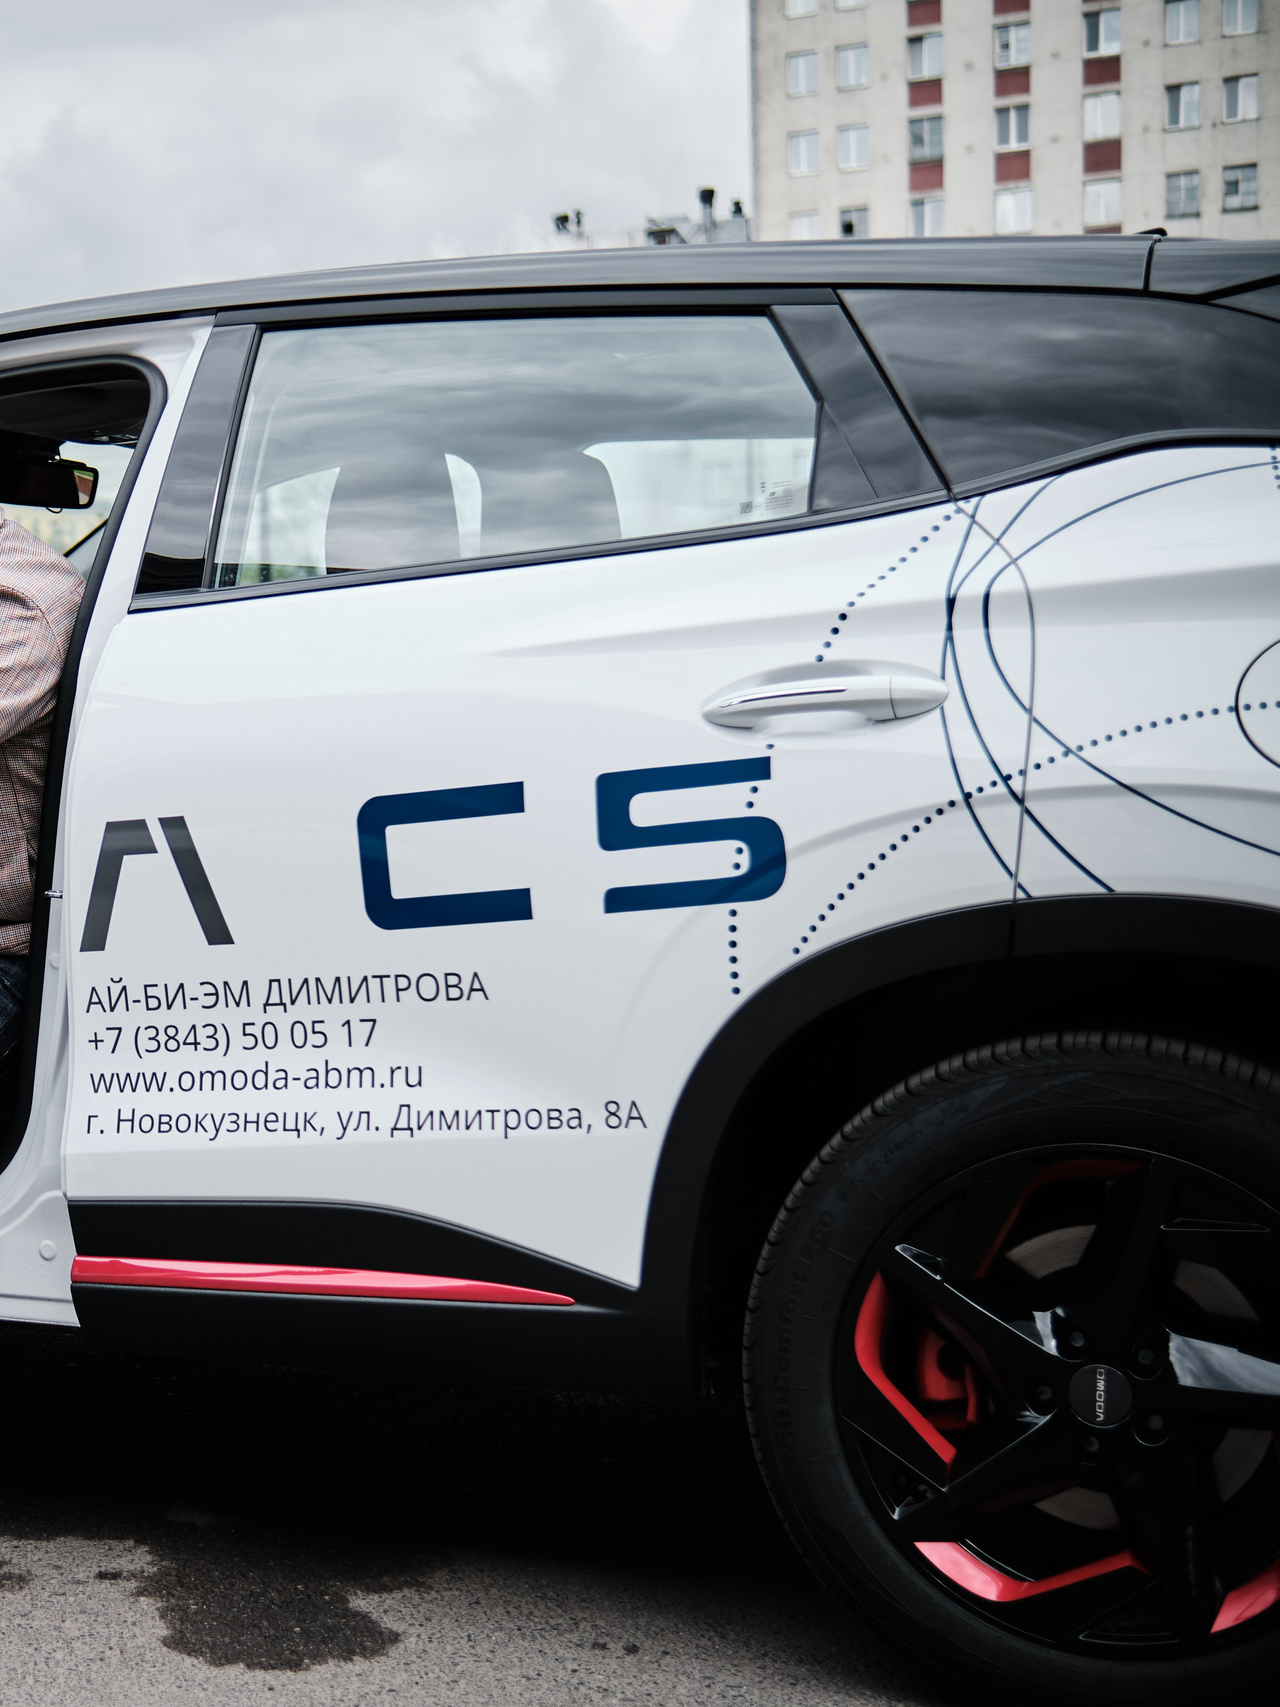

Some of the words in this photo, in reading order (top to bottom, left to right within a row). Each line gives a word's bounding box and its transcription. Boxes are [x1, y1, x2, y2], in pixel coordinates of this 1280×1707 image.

[85, 976, 252, 1014] АЙ-БИ-ЭМ
[262, 971, 490, 1015] ДИМИТРОВА
[87, 1026, 123, 1055] +7
[133, 1022, 231, 1060] (3843)
[241, 1020, 279, 1051] 50
[289, 1019, 329, 1050] 05
[340, 1018, 378, 1048] 17
[89, 1058, 423, 1094] www.omoda-abm.ru
[86, 1114, 105, 1135] г.
[116, 1107, 325, 1142] Новокузнецк,
[335, 1110, 380, 1141] ул.
[390, 1103, 592, 1140] Димитрова,
[604, 1099, 648, 1130] 8А
[773, 1271, 807, 1455] GitiComfort
[1095, 1368, 1106, 1422] OMODA
